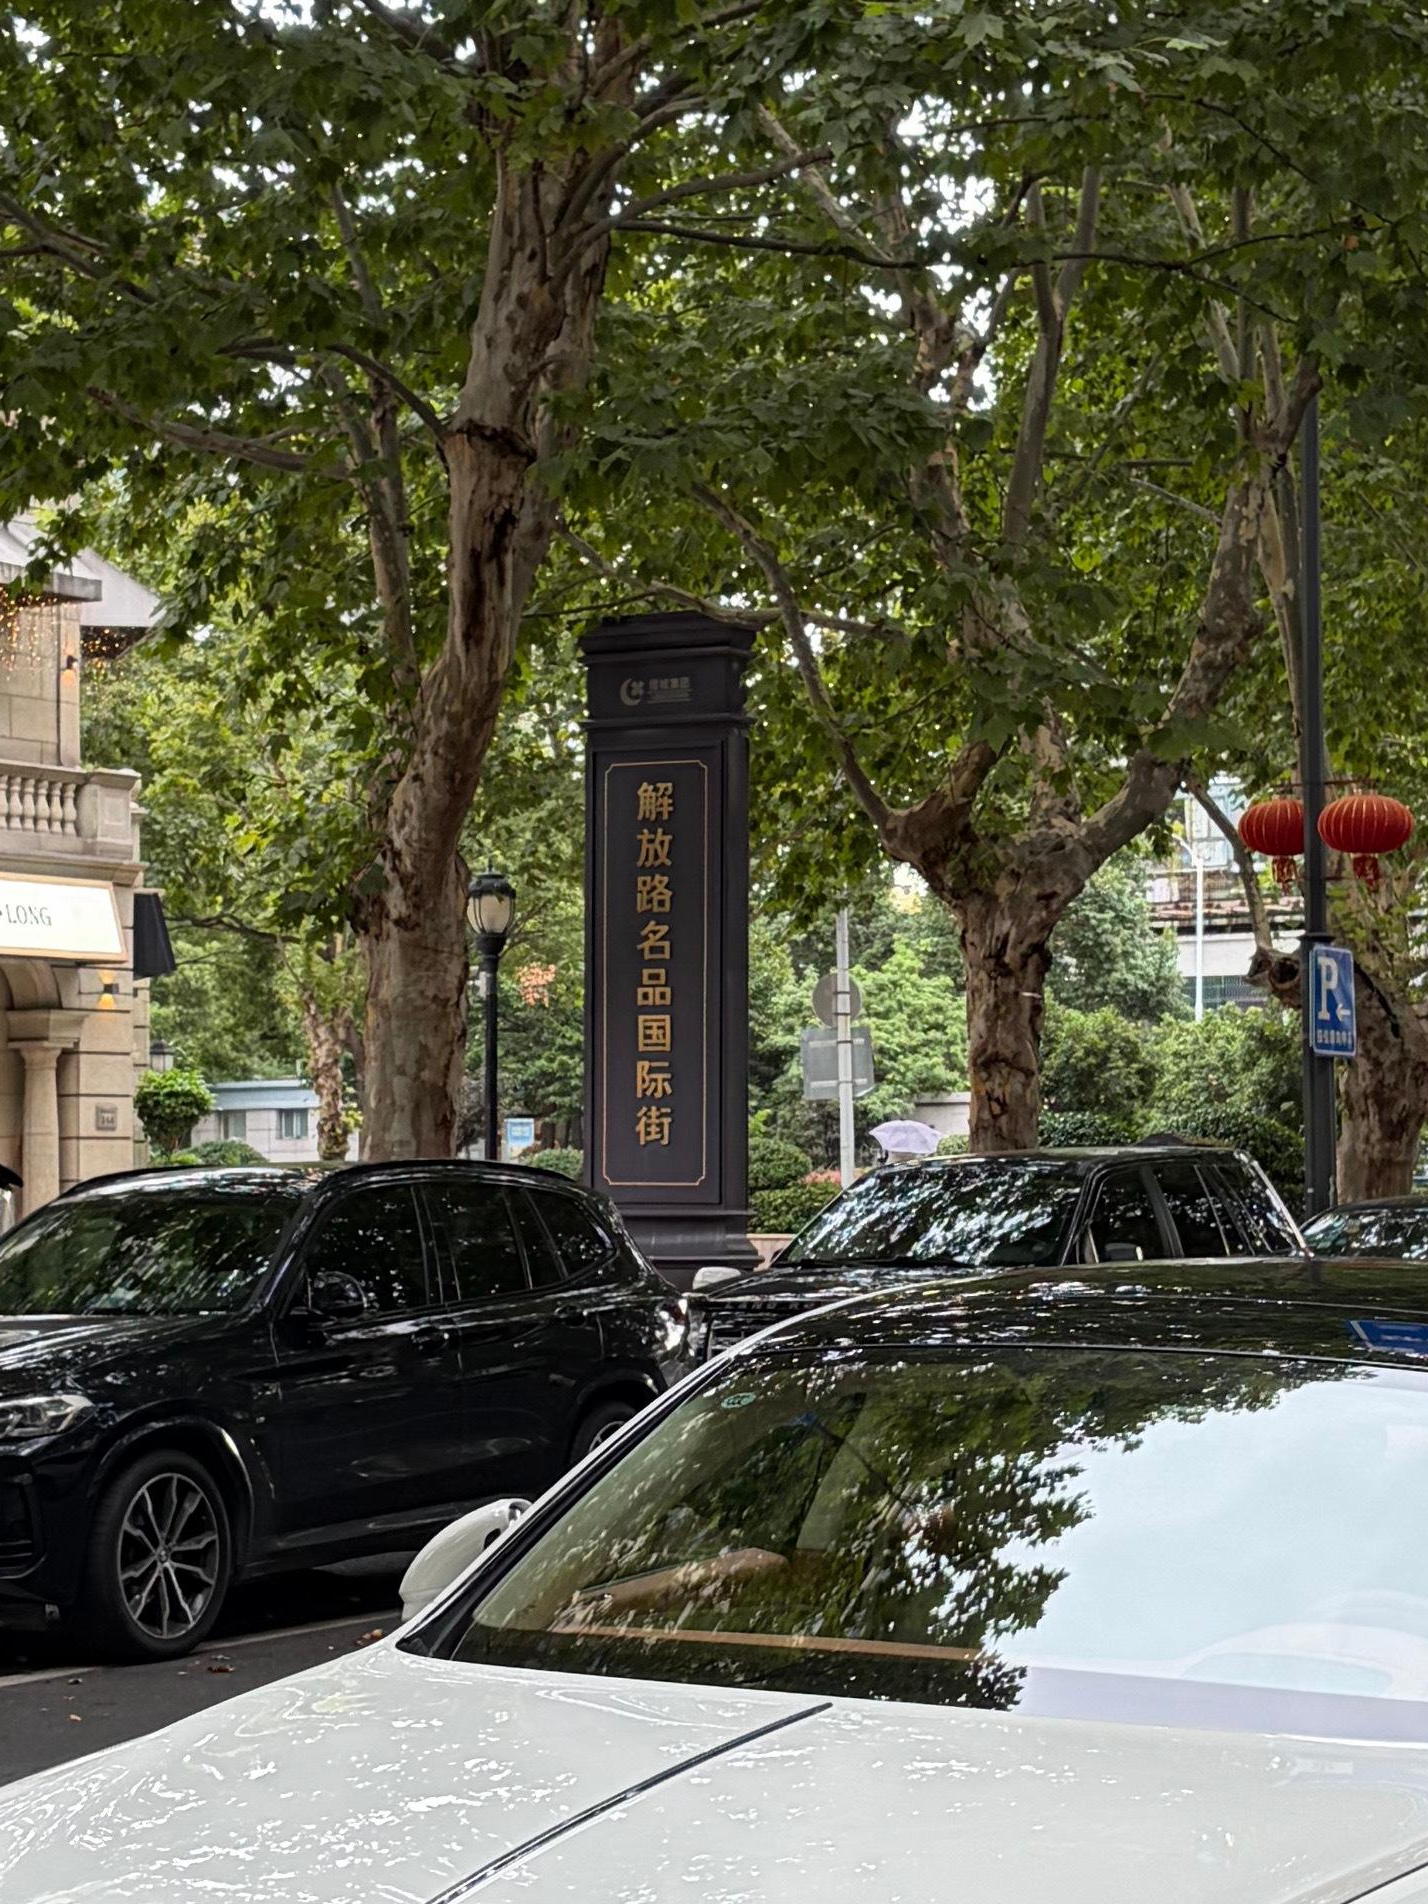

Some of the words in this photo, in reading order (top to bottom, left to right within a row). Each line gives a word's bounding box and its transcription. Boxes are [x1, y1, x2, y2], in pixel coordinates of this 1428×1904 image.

[636, 781, 674, 1146] 解放路名品国际街
[1317, 956, 1338, 1020] P
